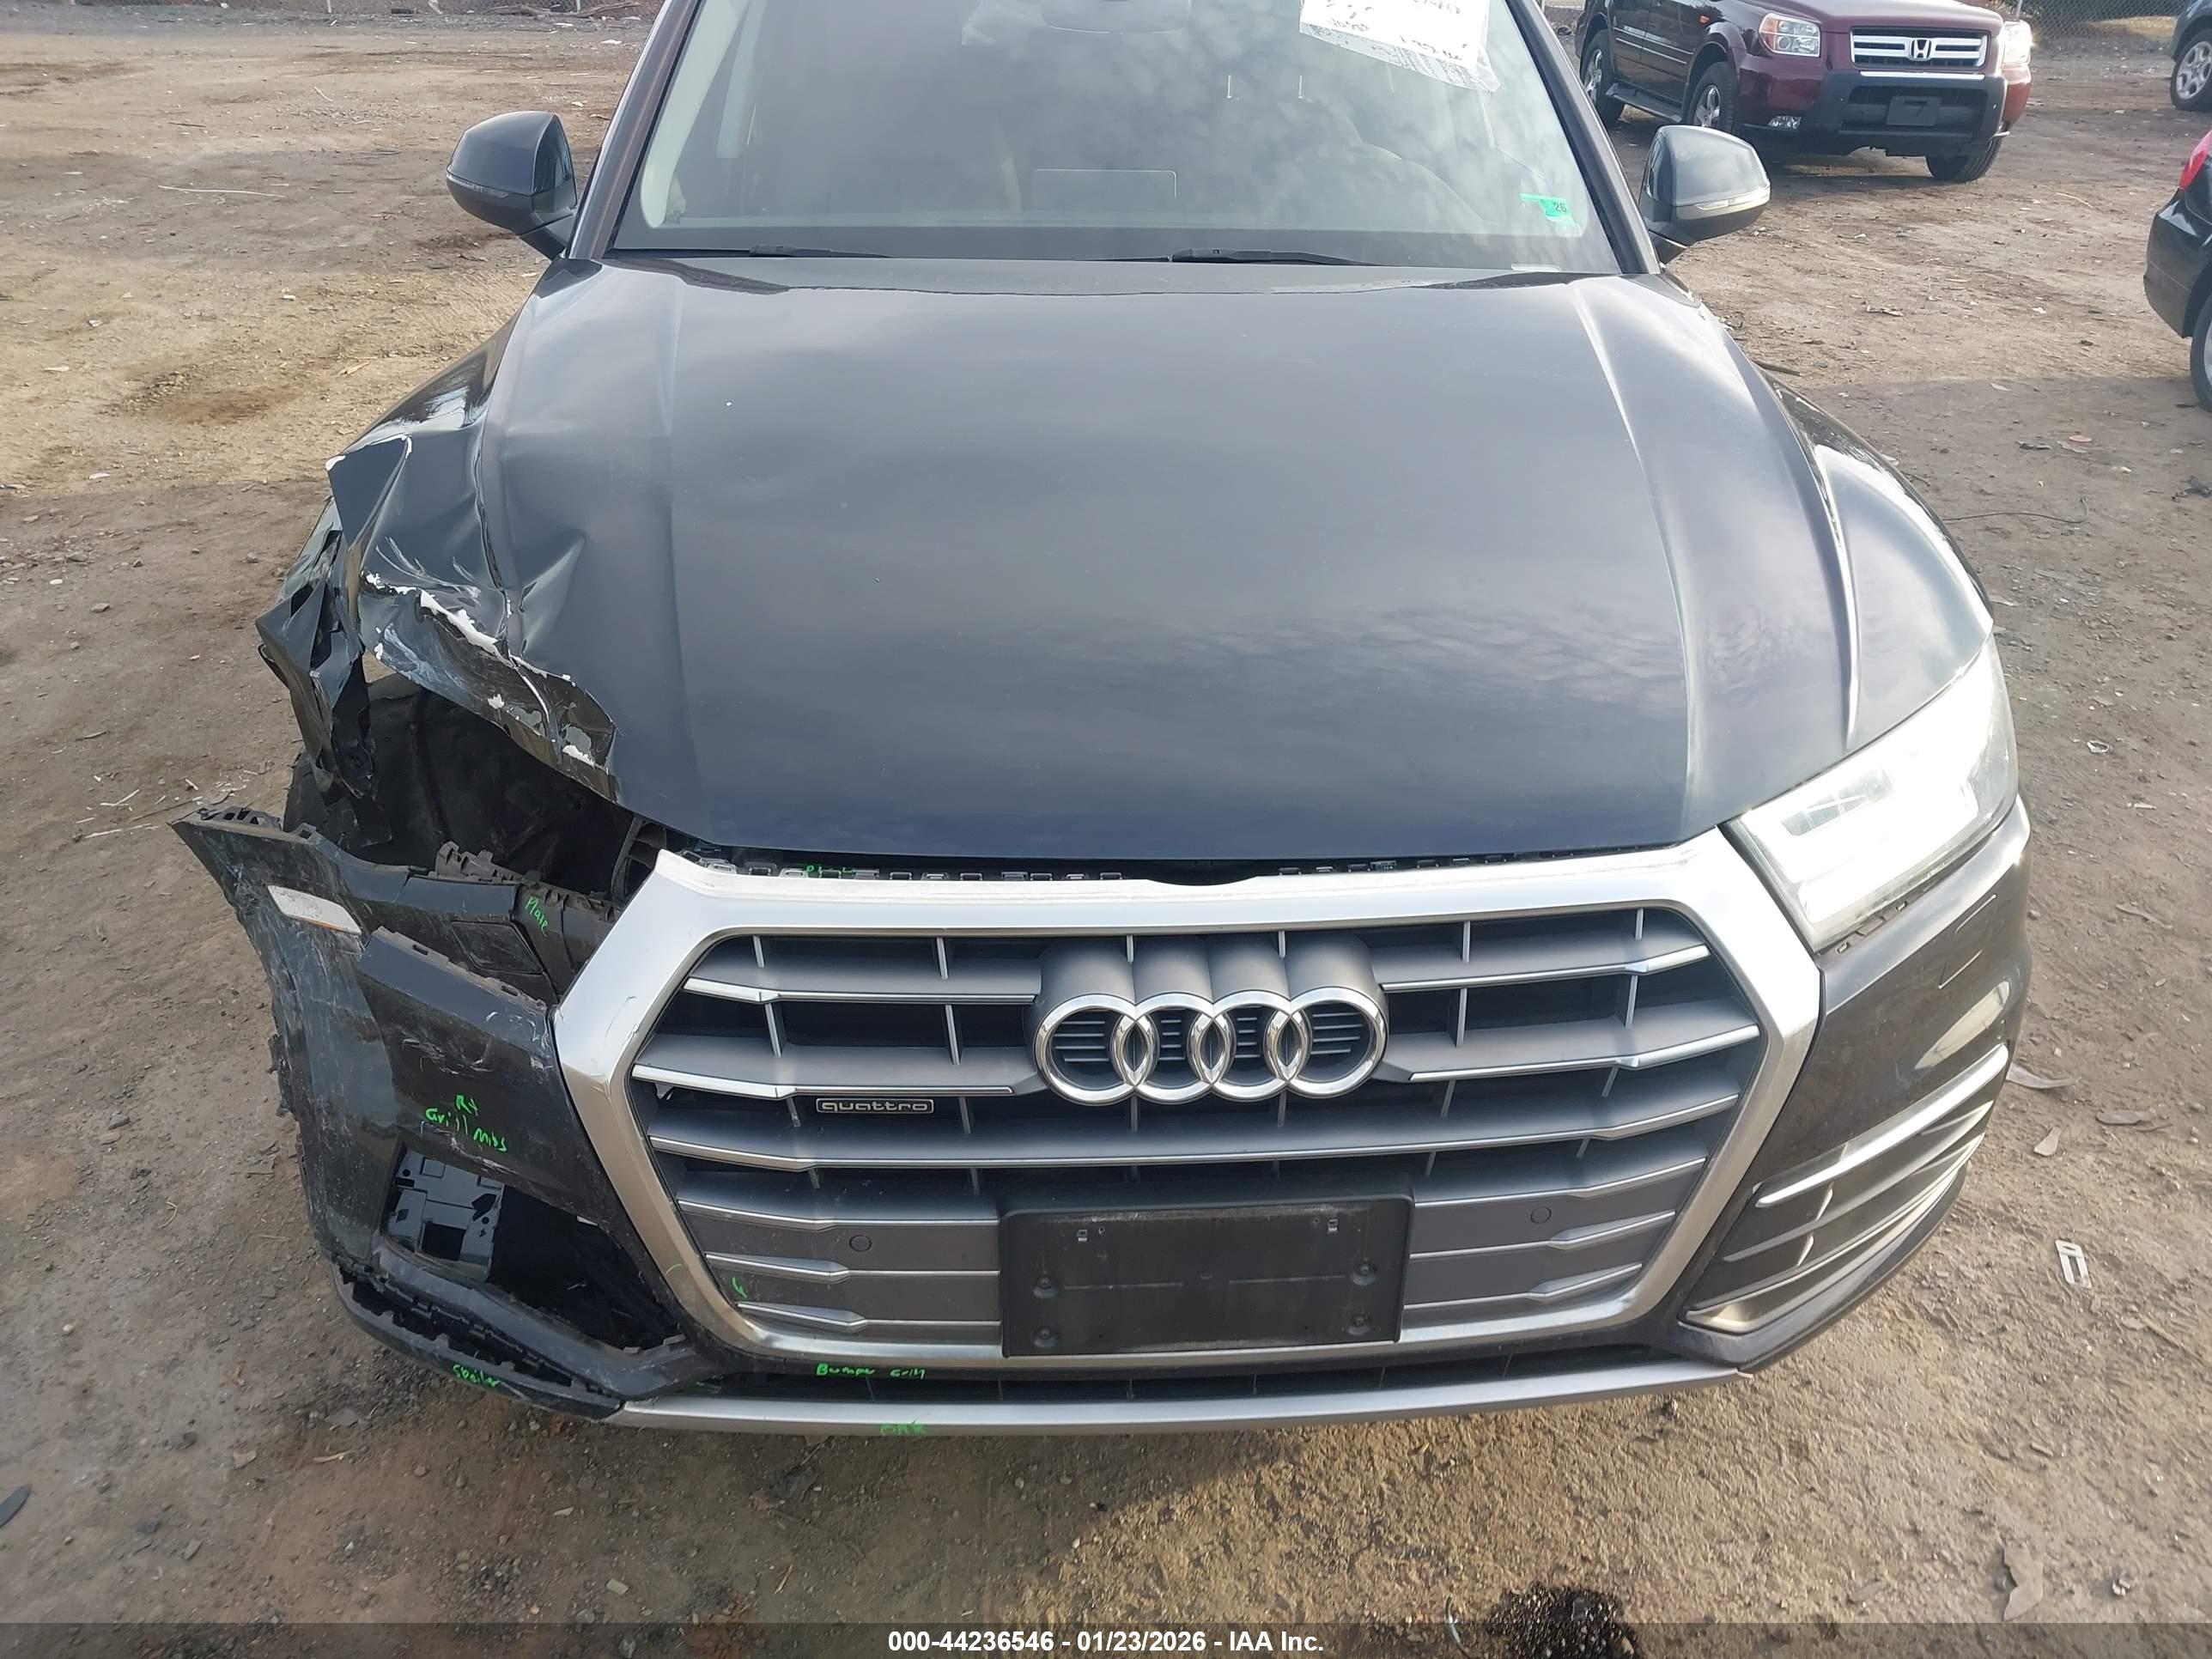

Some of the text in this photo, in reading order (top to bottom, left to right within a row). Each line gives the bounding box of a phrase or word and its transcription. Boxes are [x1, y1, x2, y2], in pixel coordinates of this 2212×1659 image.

[1553, 201, 1568, 213] 26
[821, 1101, 929, 1113] quattro
[425, 1107, 469, 1136] Grill
